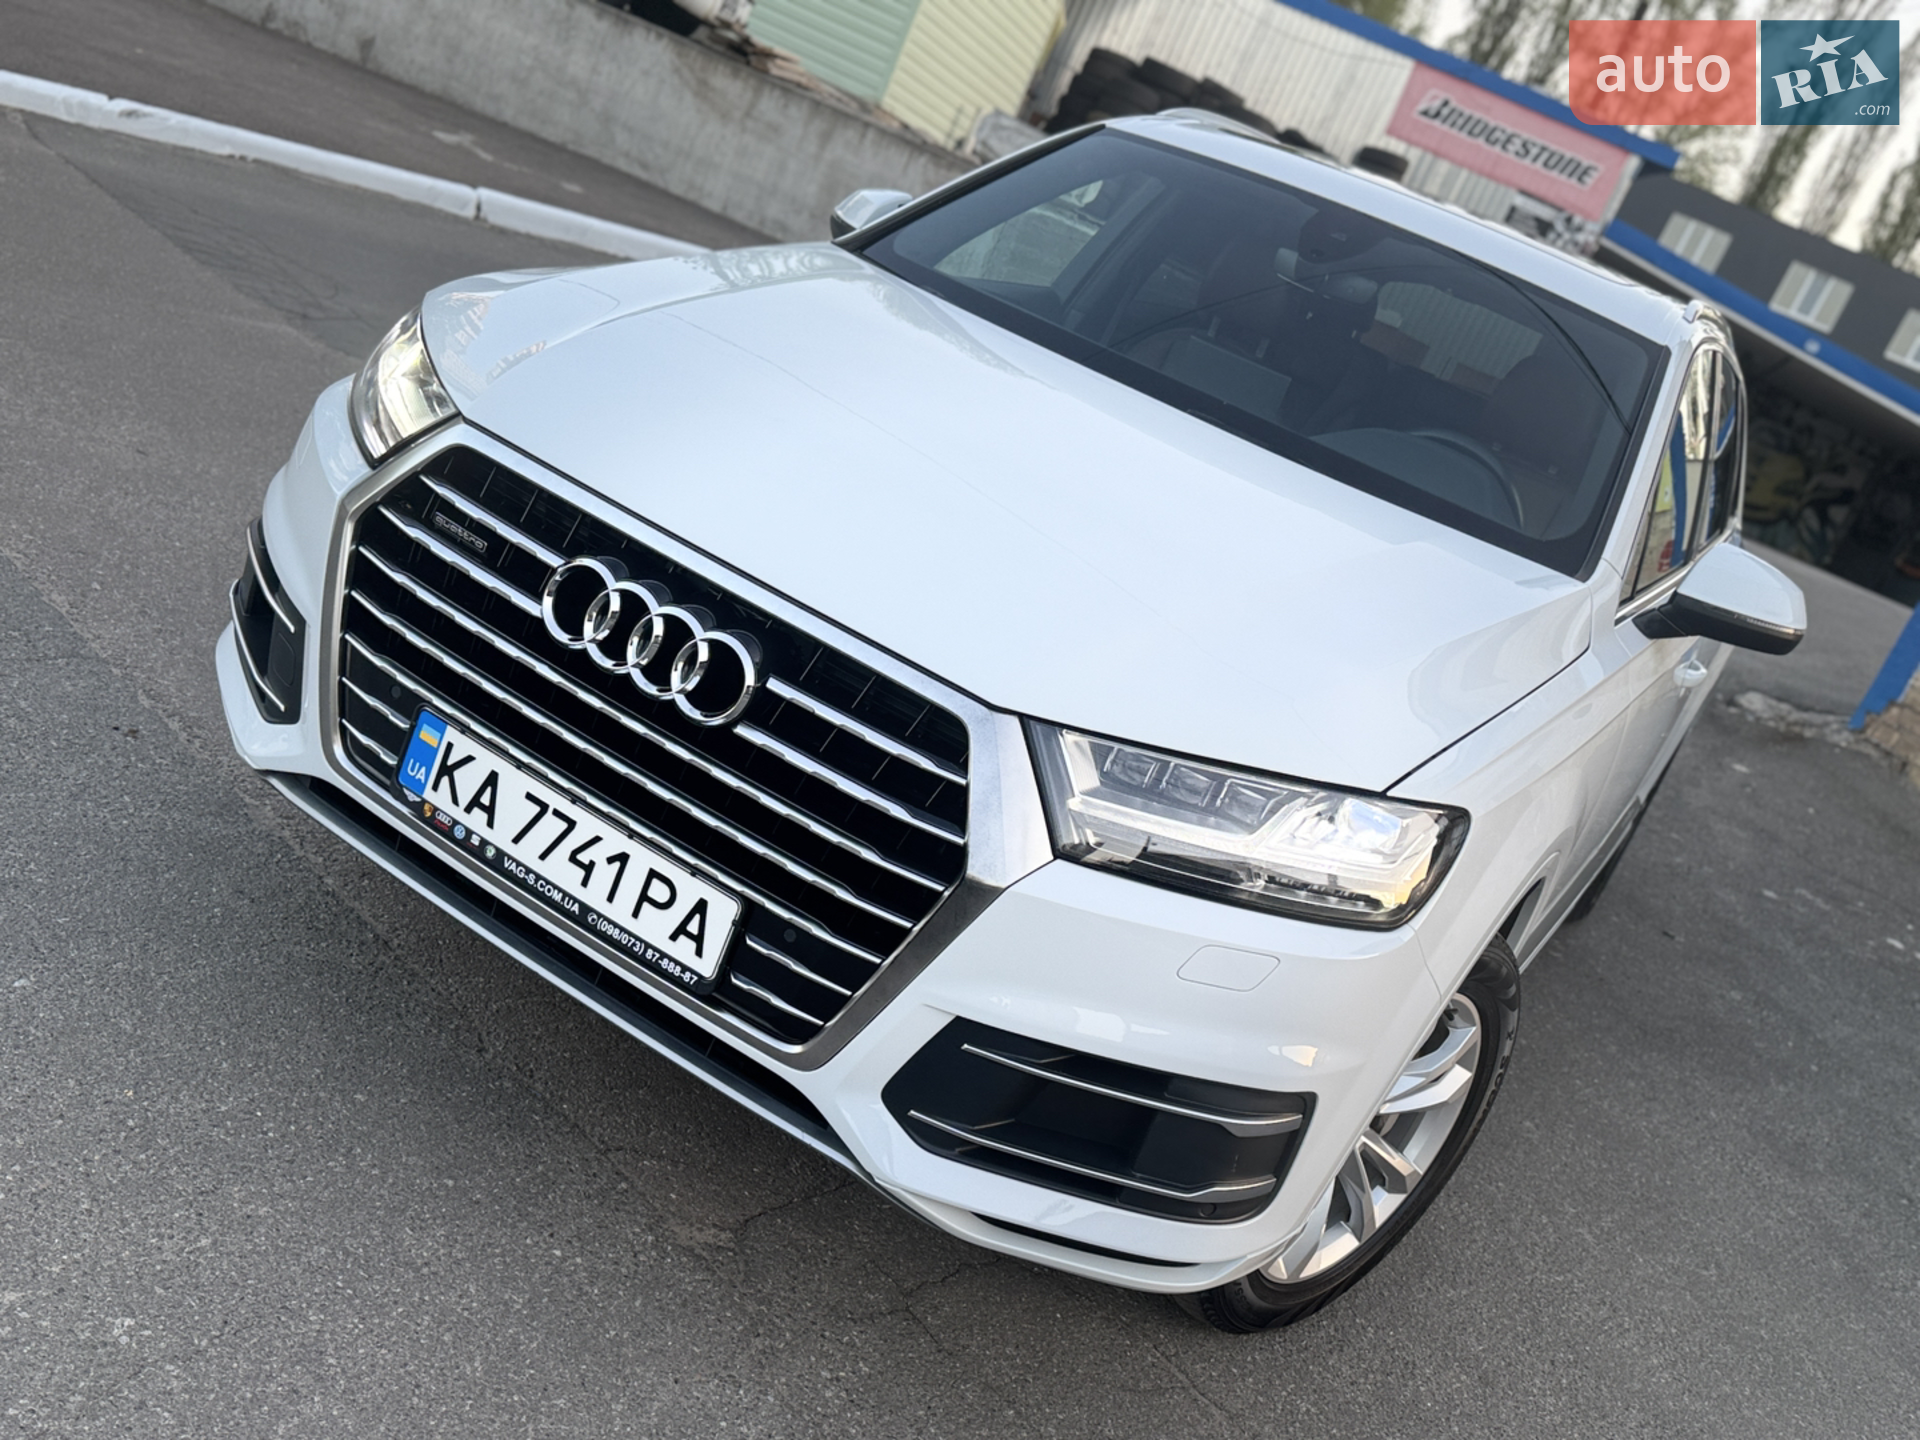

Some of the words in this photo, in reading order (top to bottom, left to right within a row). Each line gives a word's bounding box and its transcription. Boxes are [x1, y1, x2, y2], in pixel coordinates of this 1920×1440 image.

[1416, 97, 1598, 187] BRIDGESTONE
[407, 758, 427, 784] UA
[431, 741, 500, 830] KA
[511, 791, 631, 904] 7741
[631, 867, 709, 960] PA
[503, 856, 580, 915] VAG-S.COM.UA
[597, 917, 645, 956] (098/073)
[645, 949, 698, 986] 87-888-87
